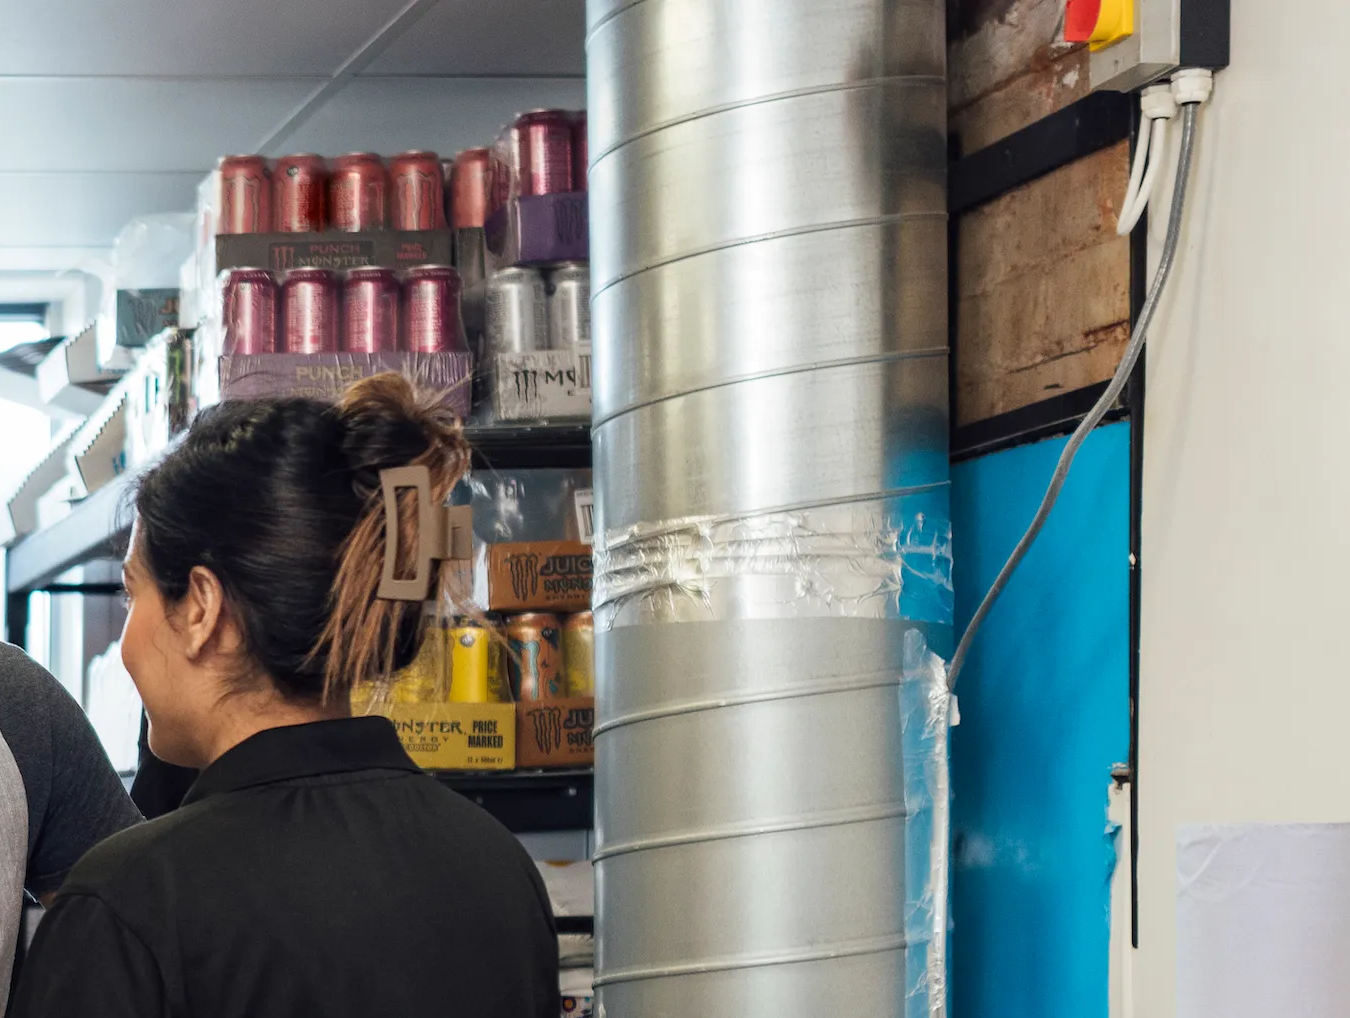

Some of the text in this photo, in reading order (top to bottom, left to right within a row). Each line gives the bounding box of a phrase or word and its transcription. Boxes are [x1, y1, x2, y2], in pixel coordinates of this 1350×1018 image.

[309, 244, 360, 254] PUNCH
[541, 555, 593, 576] JUIC
[472, 720, 498, 734] PRICE
[468, 735, 504, 749] MARKED
